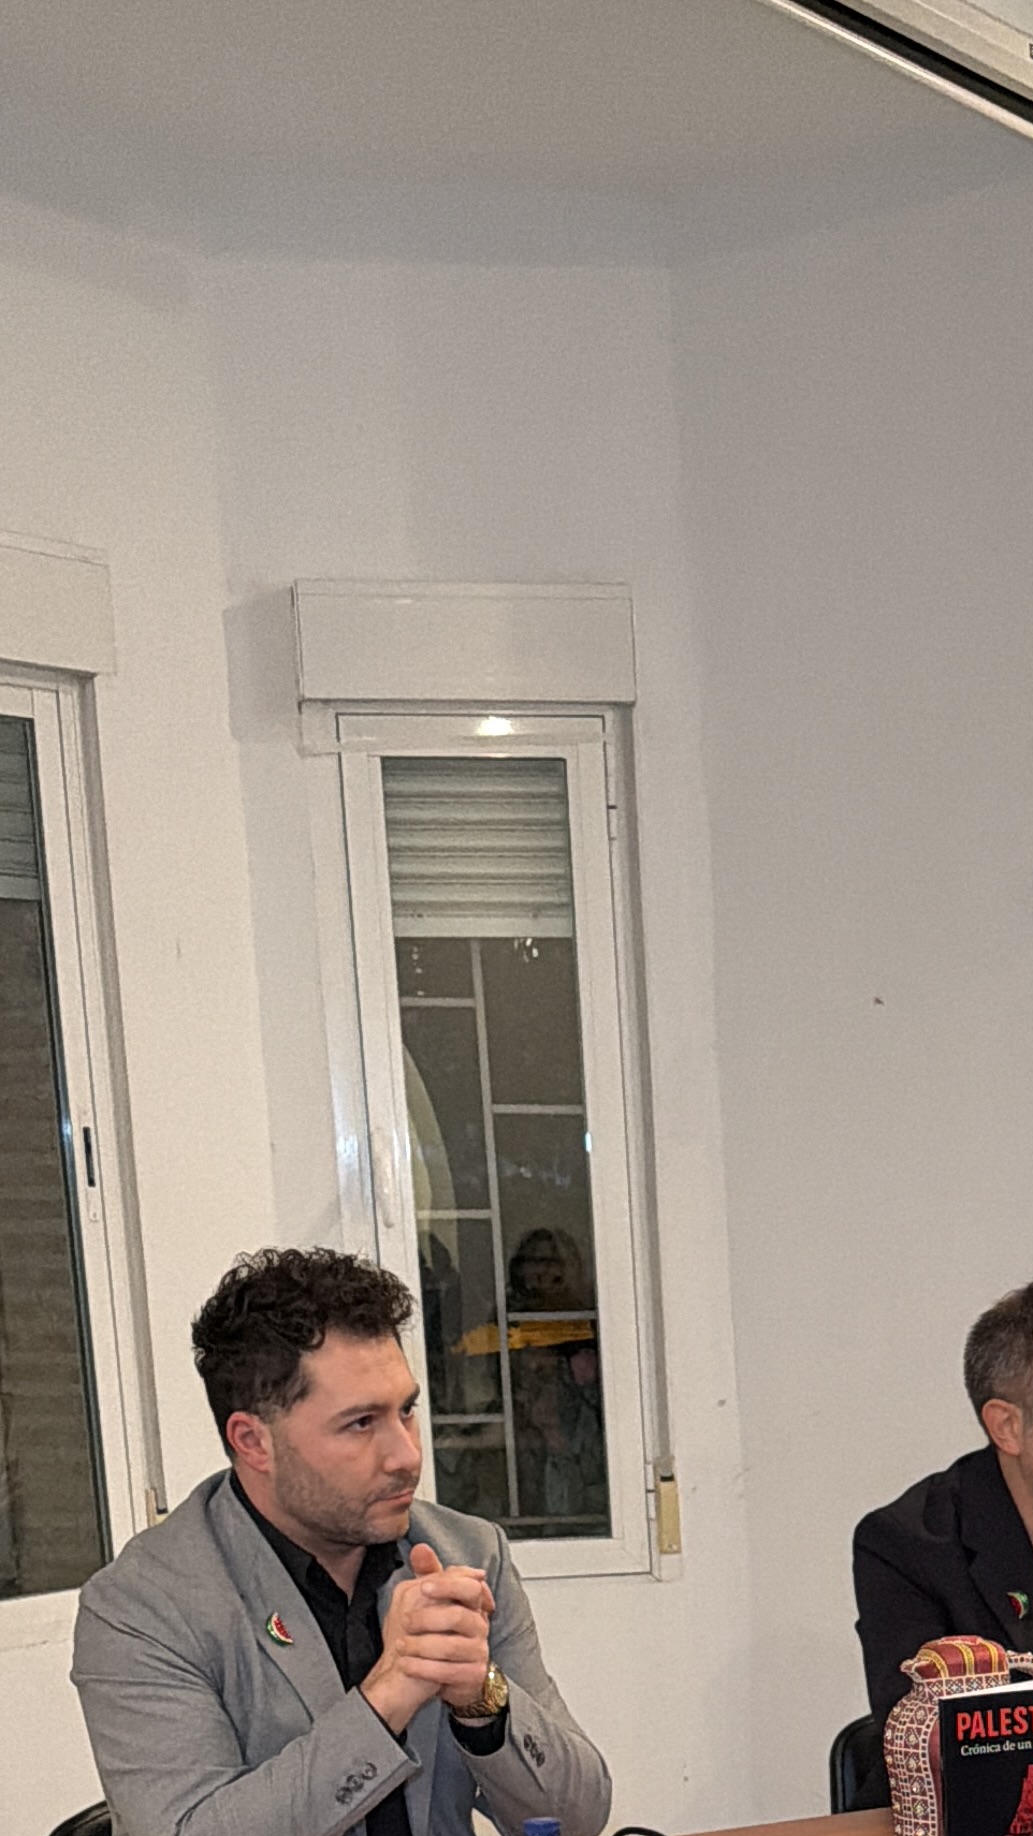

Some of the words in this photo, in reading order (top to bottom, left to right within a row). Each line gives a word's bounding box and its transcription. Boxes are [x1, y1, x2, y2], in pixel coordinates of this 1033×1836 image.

[960, 1743, 1001, 1756] Crónica
[1002, 1740, 1016, 1751] de
[1017, 1740, 1032, 1750] un
